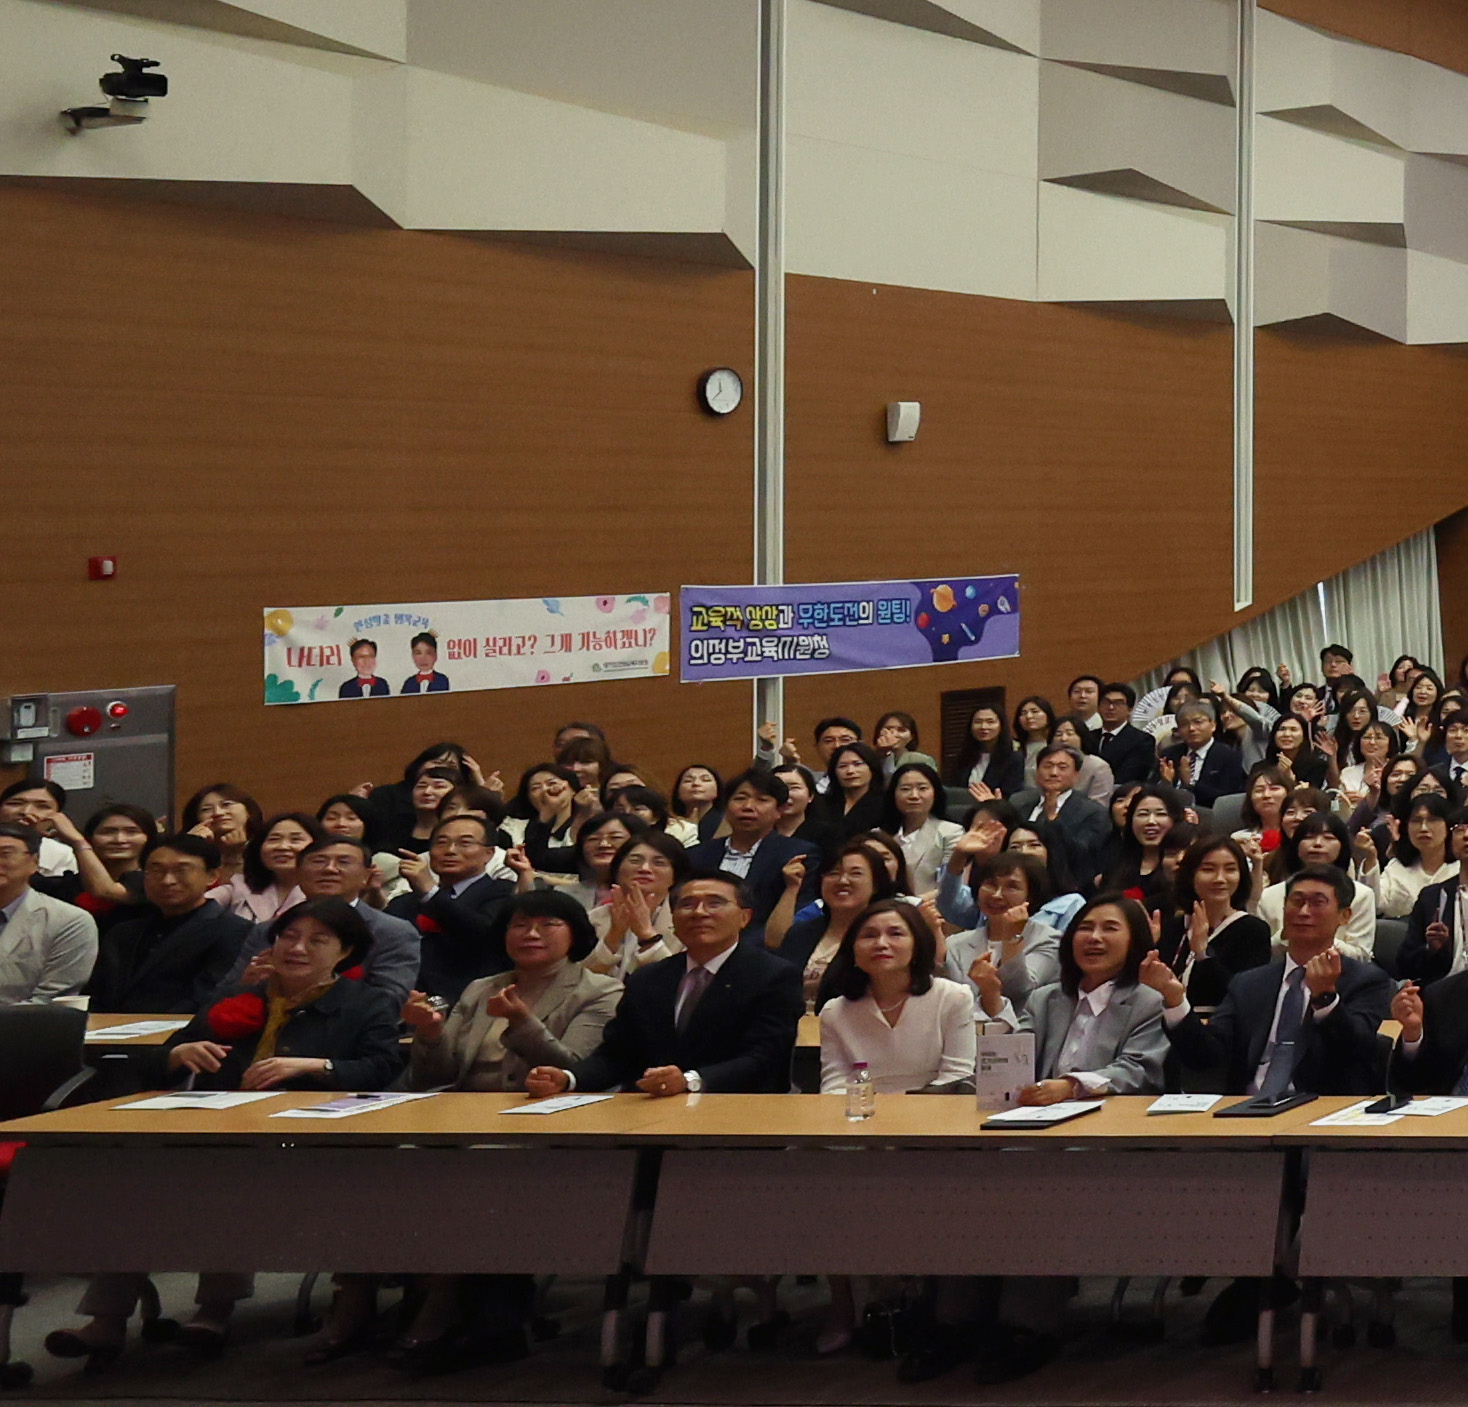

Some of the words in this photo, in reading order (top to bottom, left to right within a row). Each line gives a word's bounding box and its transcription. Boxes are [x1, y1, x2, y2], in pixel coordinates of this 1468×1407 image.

[690, 606, 744, 632] 교육적
[745, 603, 794, 631] 상상과
[797, 600, 873, 629] 무한도전의
[447, 637, 478, 660] 없이
[483, 634, 538, 658] 살라고?
[543, 632, 572, 654] 그게
